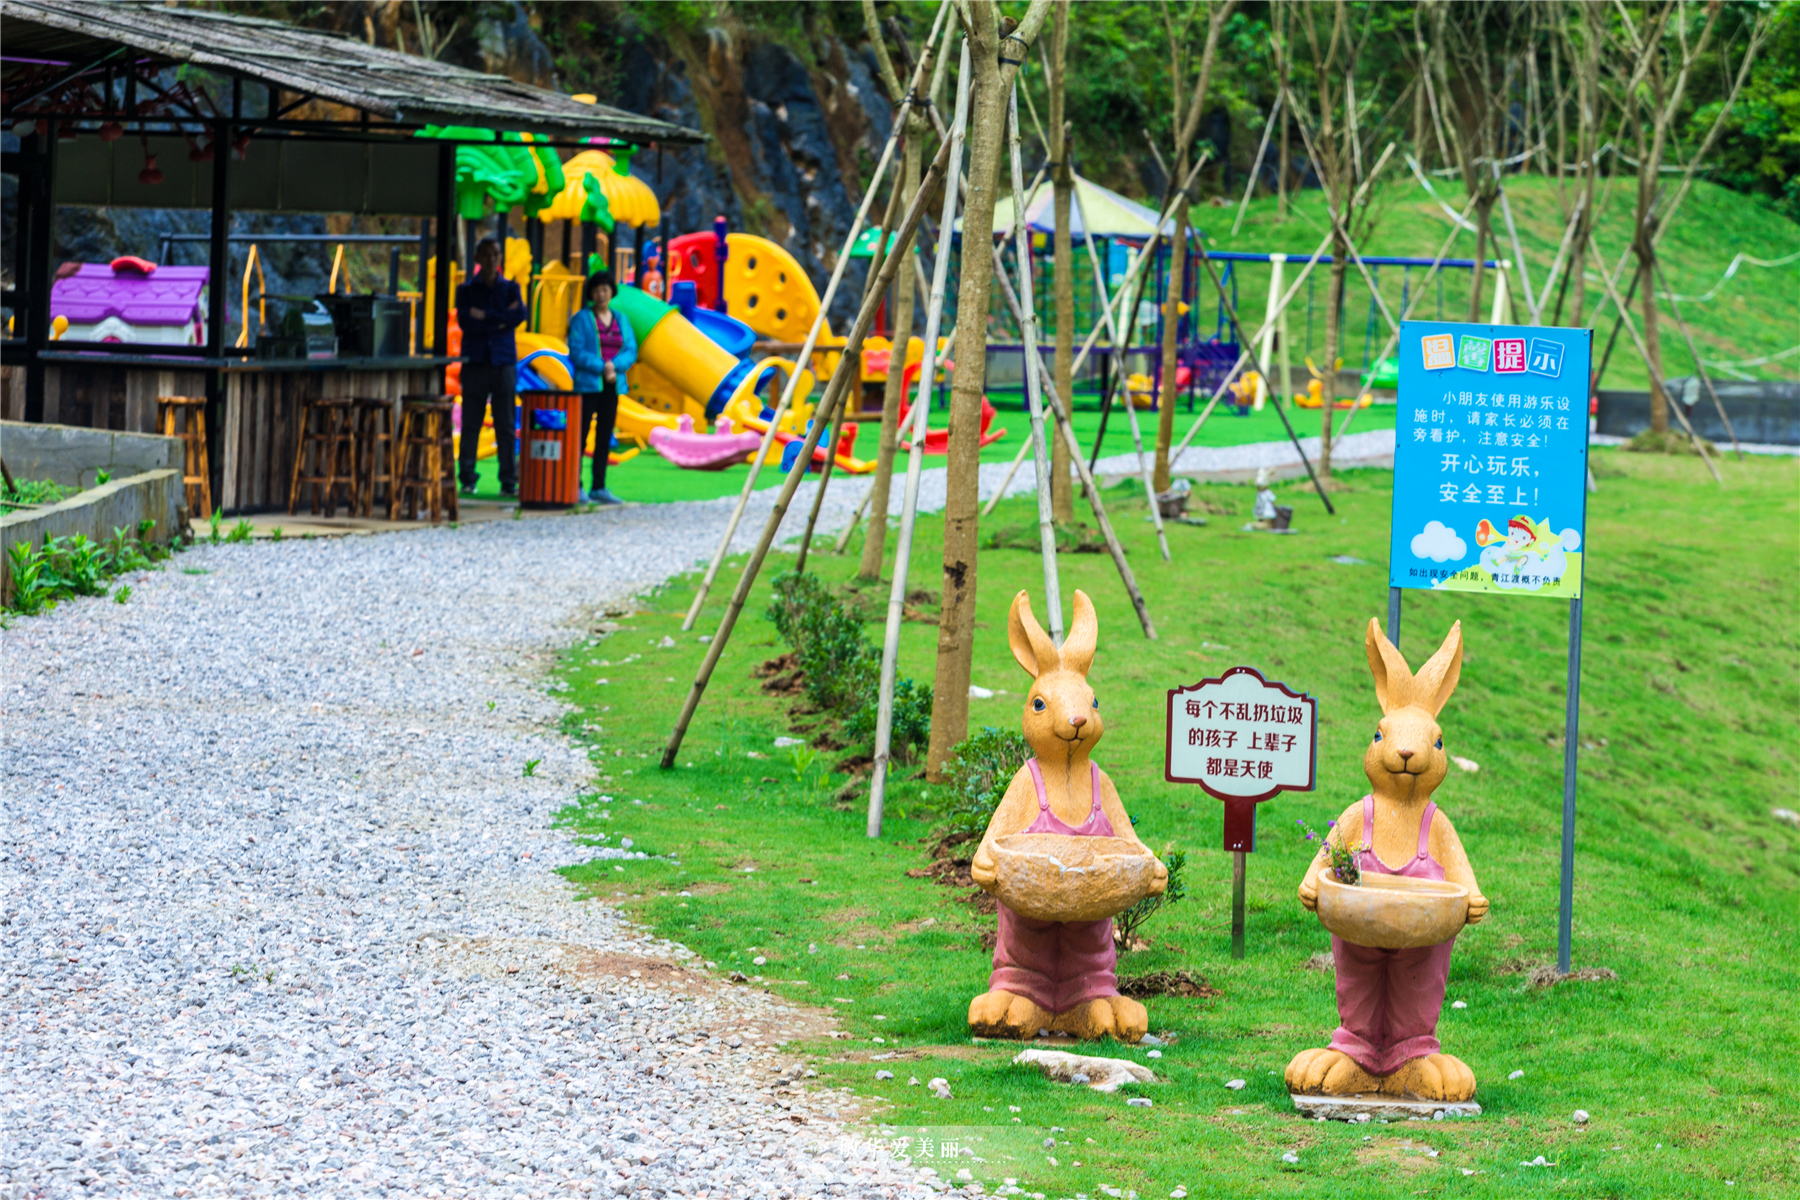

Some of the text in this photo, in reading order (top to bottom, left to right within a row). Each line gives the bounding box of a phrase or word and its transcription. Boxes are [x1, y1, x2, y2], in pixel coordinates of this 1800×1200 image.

[1424, 337, 1560, 373] 温馨提示
[1442, 390, 1570, 411] 小朋友使用游乐设
[1413, 408, 1570, 430] 施时，请家长必须在
[1413, 427, 1548, 448] 旁看护，注意安全！
[1440, 453, 1539, 477] 开心玩乐，
[1439, 481, 1539, 506] 安全至上！
[1185, 698, 1303, 725] 每个不乱扔垃圾
[1188, 728, 1297, 753] 的孩子 上辈子
[1206, 756, 1274, 780] 都是天使
